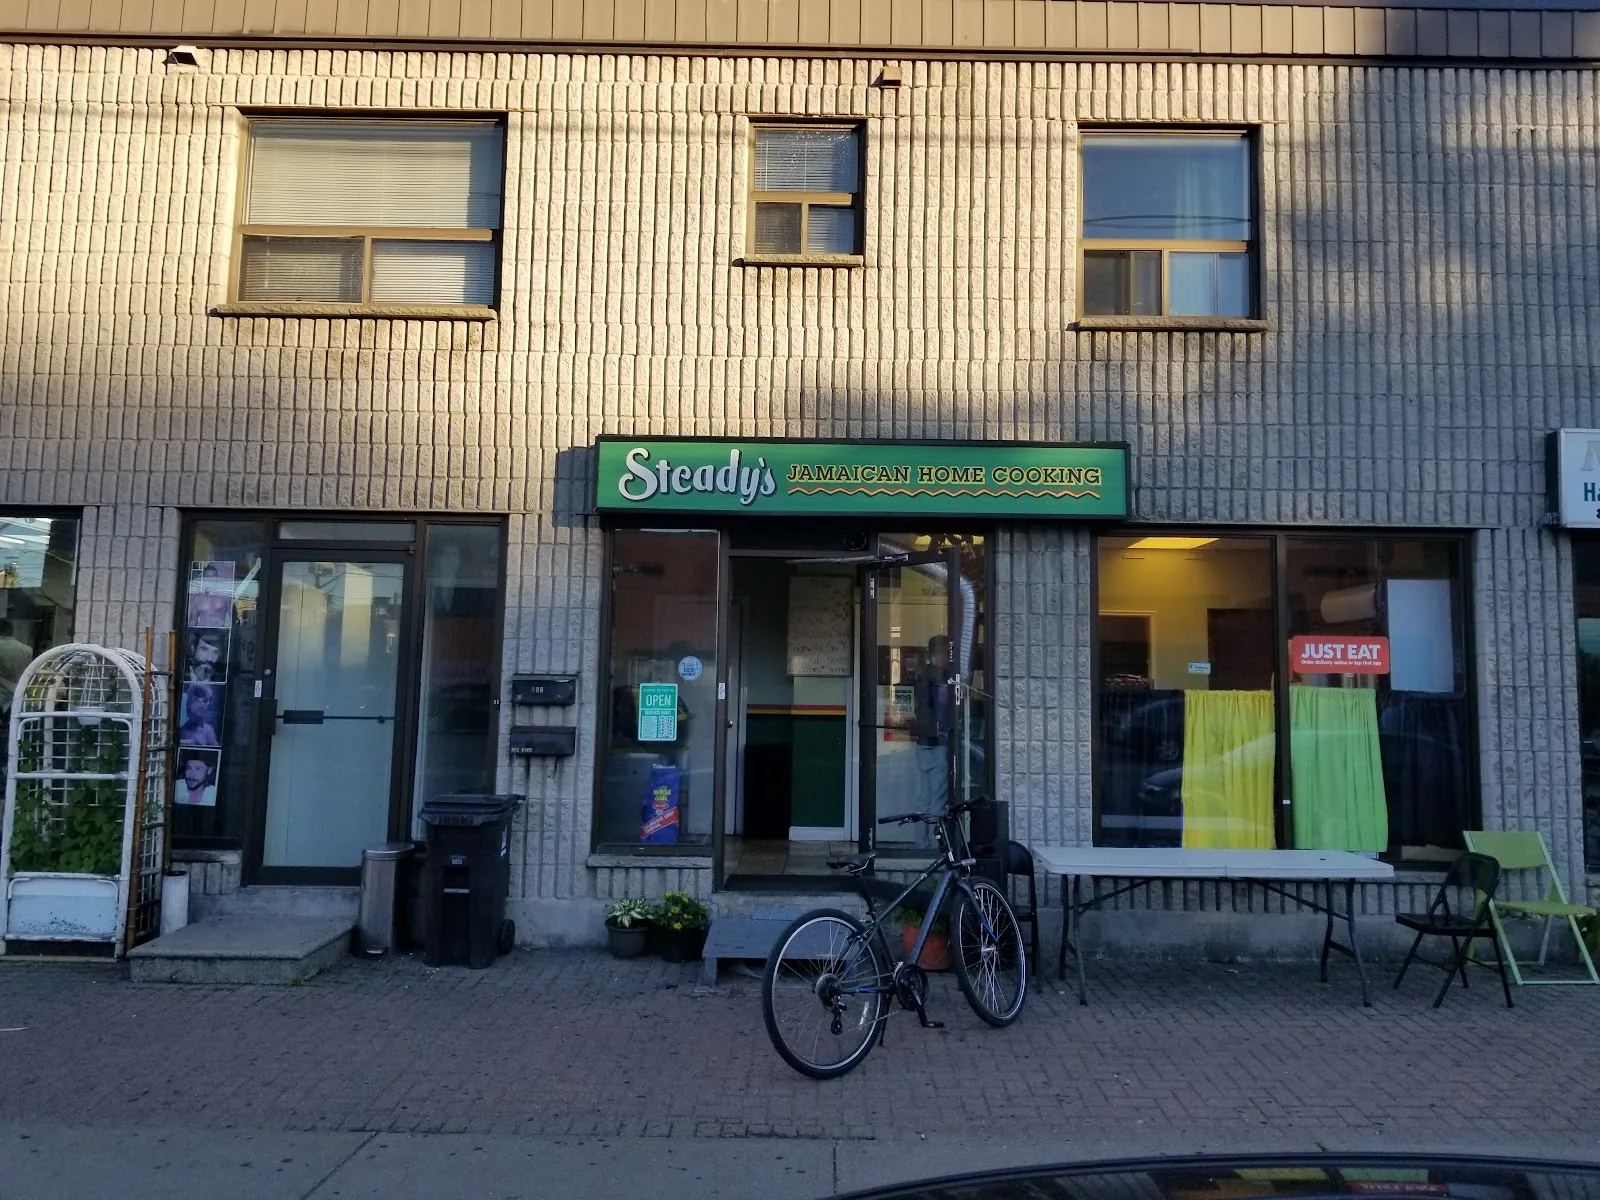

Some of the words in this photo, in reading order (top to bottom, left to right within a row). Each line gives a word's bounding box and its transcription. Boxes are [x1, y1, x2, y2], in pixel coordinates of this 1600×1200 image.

[618, 447, 777, 505] Steady's
[786, 462, 910, 484] JAMAICAN
[918, 465, 985, 485] HOME
[991, 466, 1102, 486] COOKING
[1301, 643, 1344, 659] JUST
[1347, 644, 1380, 659] EAT
[645, 694, 671, 706] OPEN
